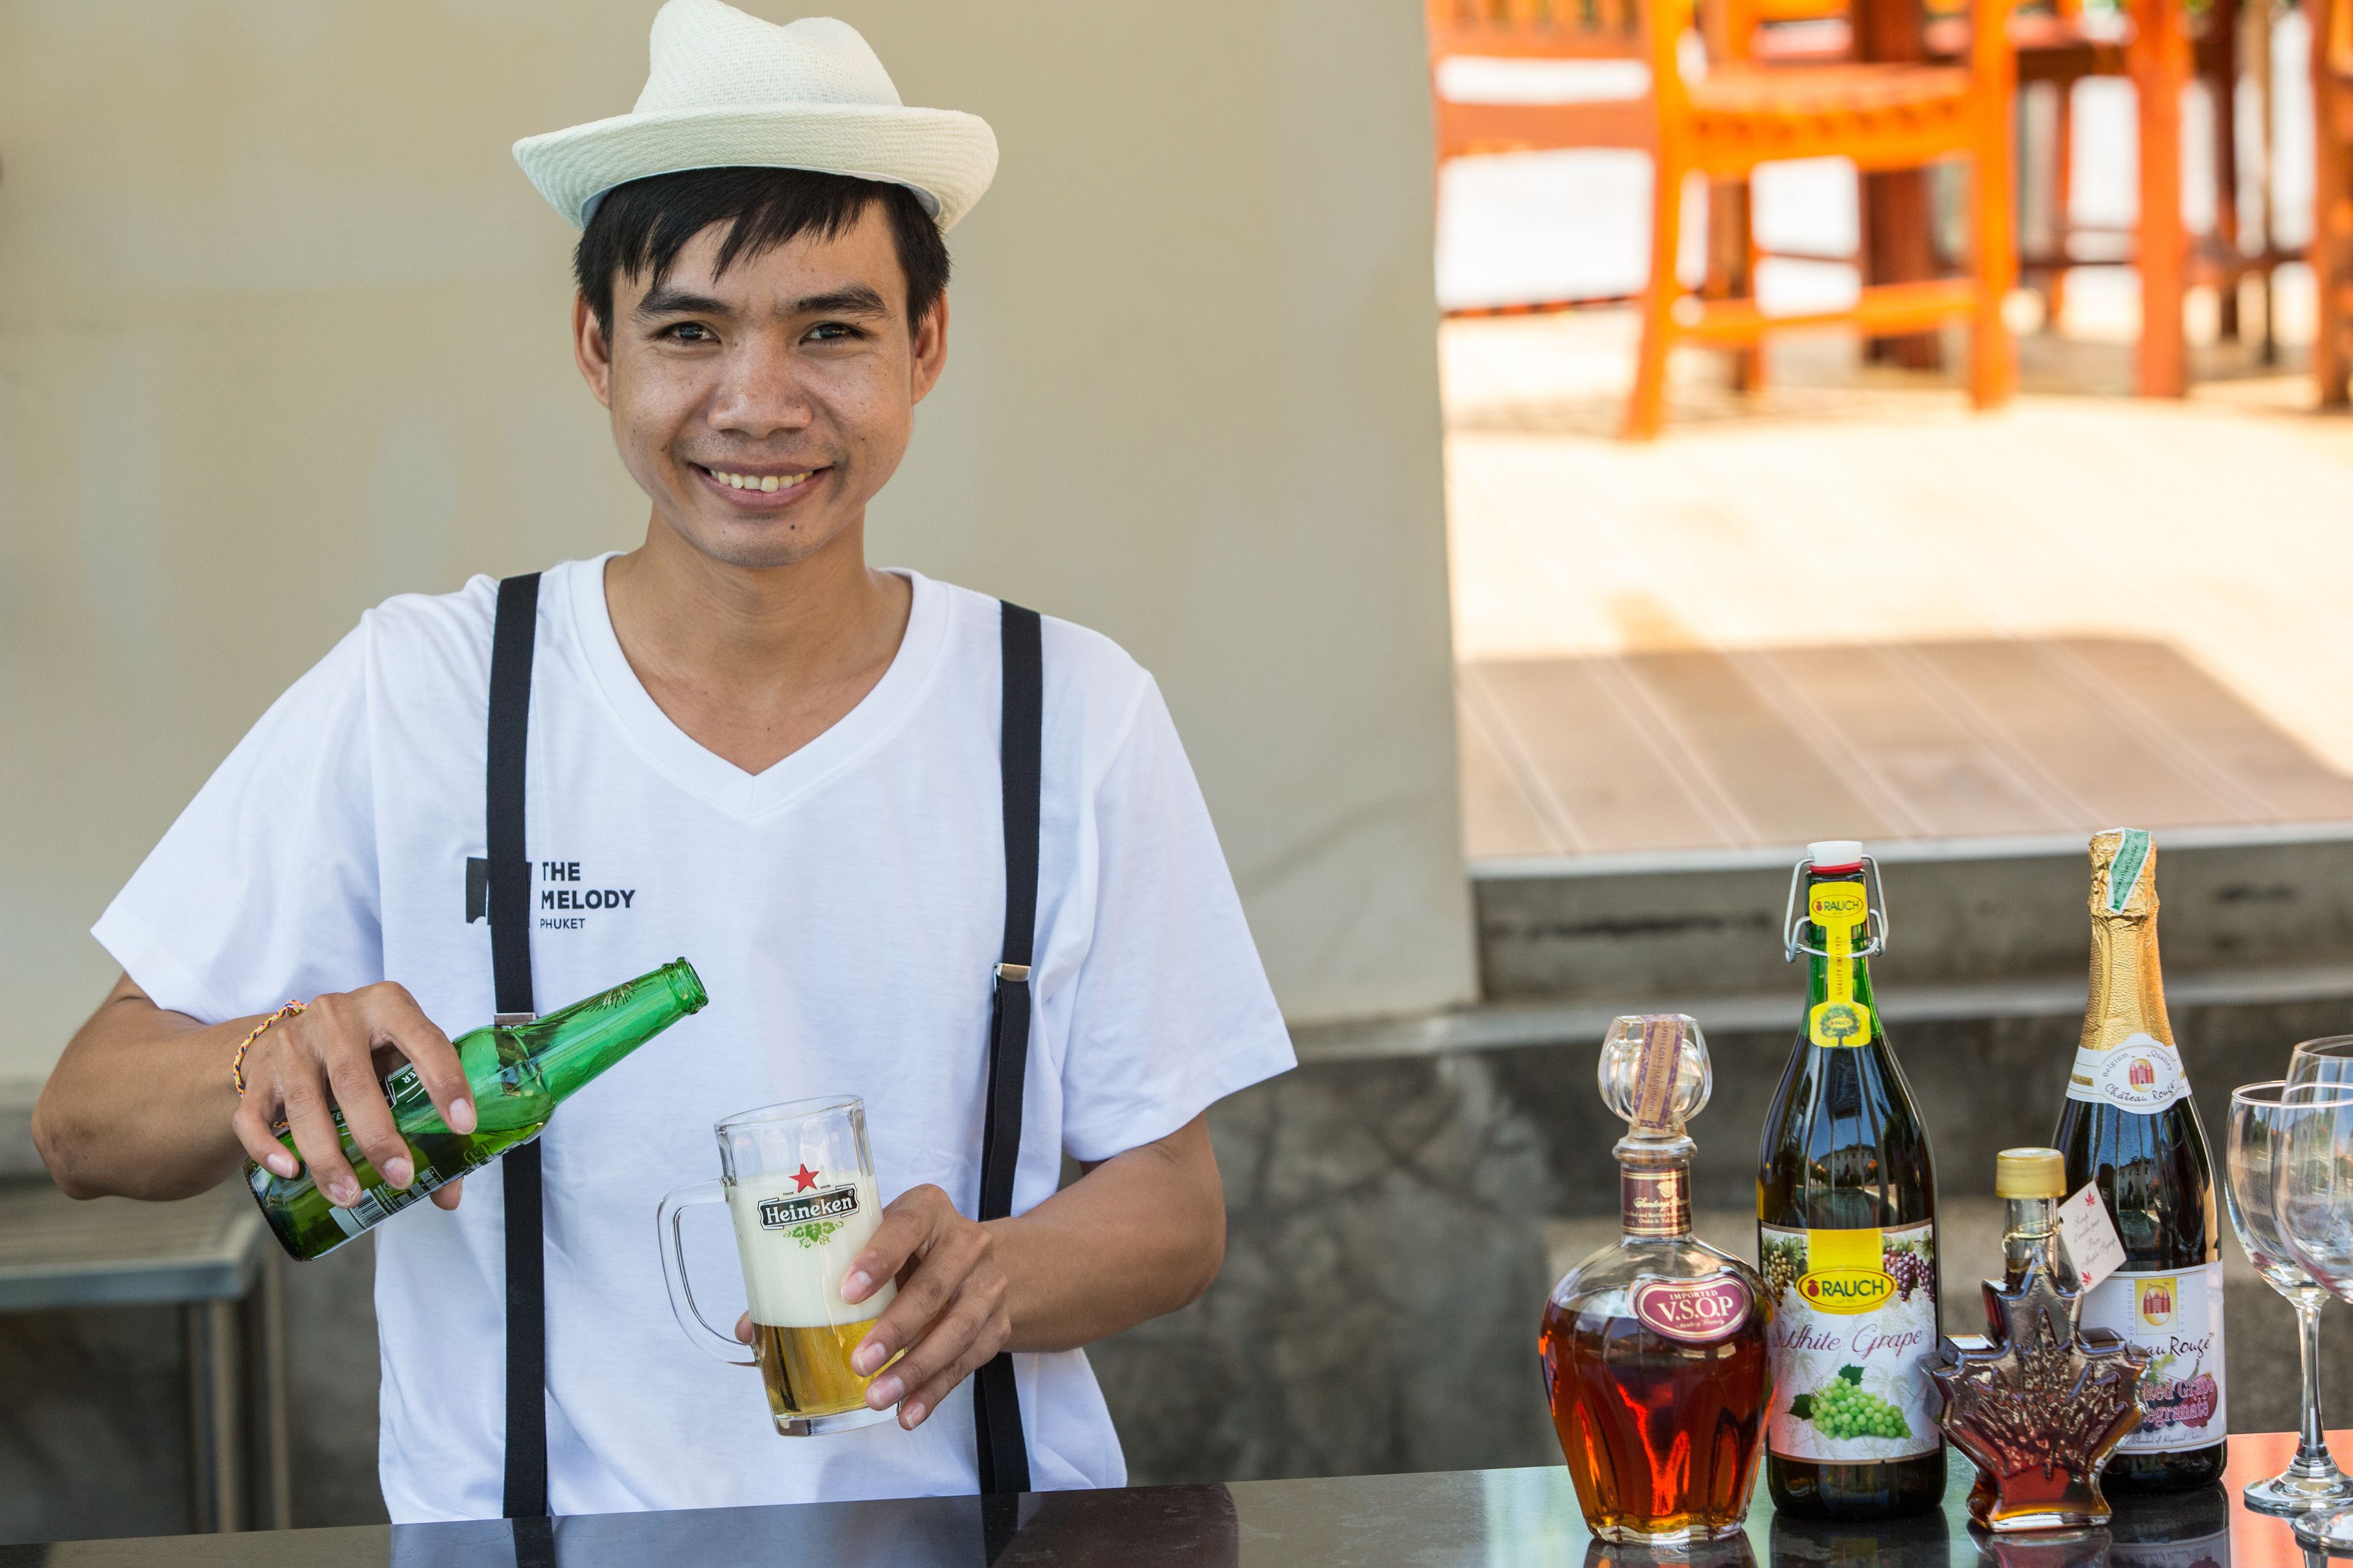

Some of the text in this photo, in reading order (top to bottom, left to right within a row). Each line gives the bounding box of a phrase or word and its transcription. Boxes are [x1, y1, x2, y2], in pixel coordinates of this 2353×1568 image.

[542, 862, 580, 881] THE
[542, 890, 635, 909] MELODY
[1824, 900, 1860, 911] RAUCH
[540, 918, 585, 929] PHUKET
[2102, 1050, 2173, 1077] Belgium Quality
[765, 1196, 854, 1224] Heineken
[1669, 1289, 1718, 1301] IMPORTED
[1822, 1279, 1884, 1297] RAUCH
[1657, 1296, 1733, 1322] V.S.O.P
[1779, 1320, 1922, 1360] White Grape
[2170, 1336, 2210, 1358] Rouge
[2145, 1378, 2215, 1401] Red Grape
[2146, 1397, 2210, 1428] egranate
